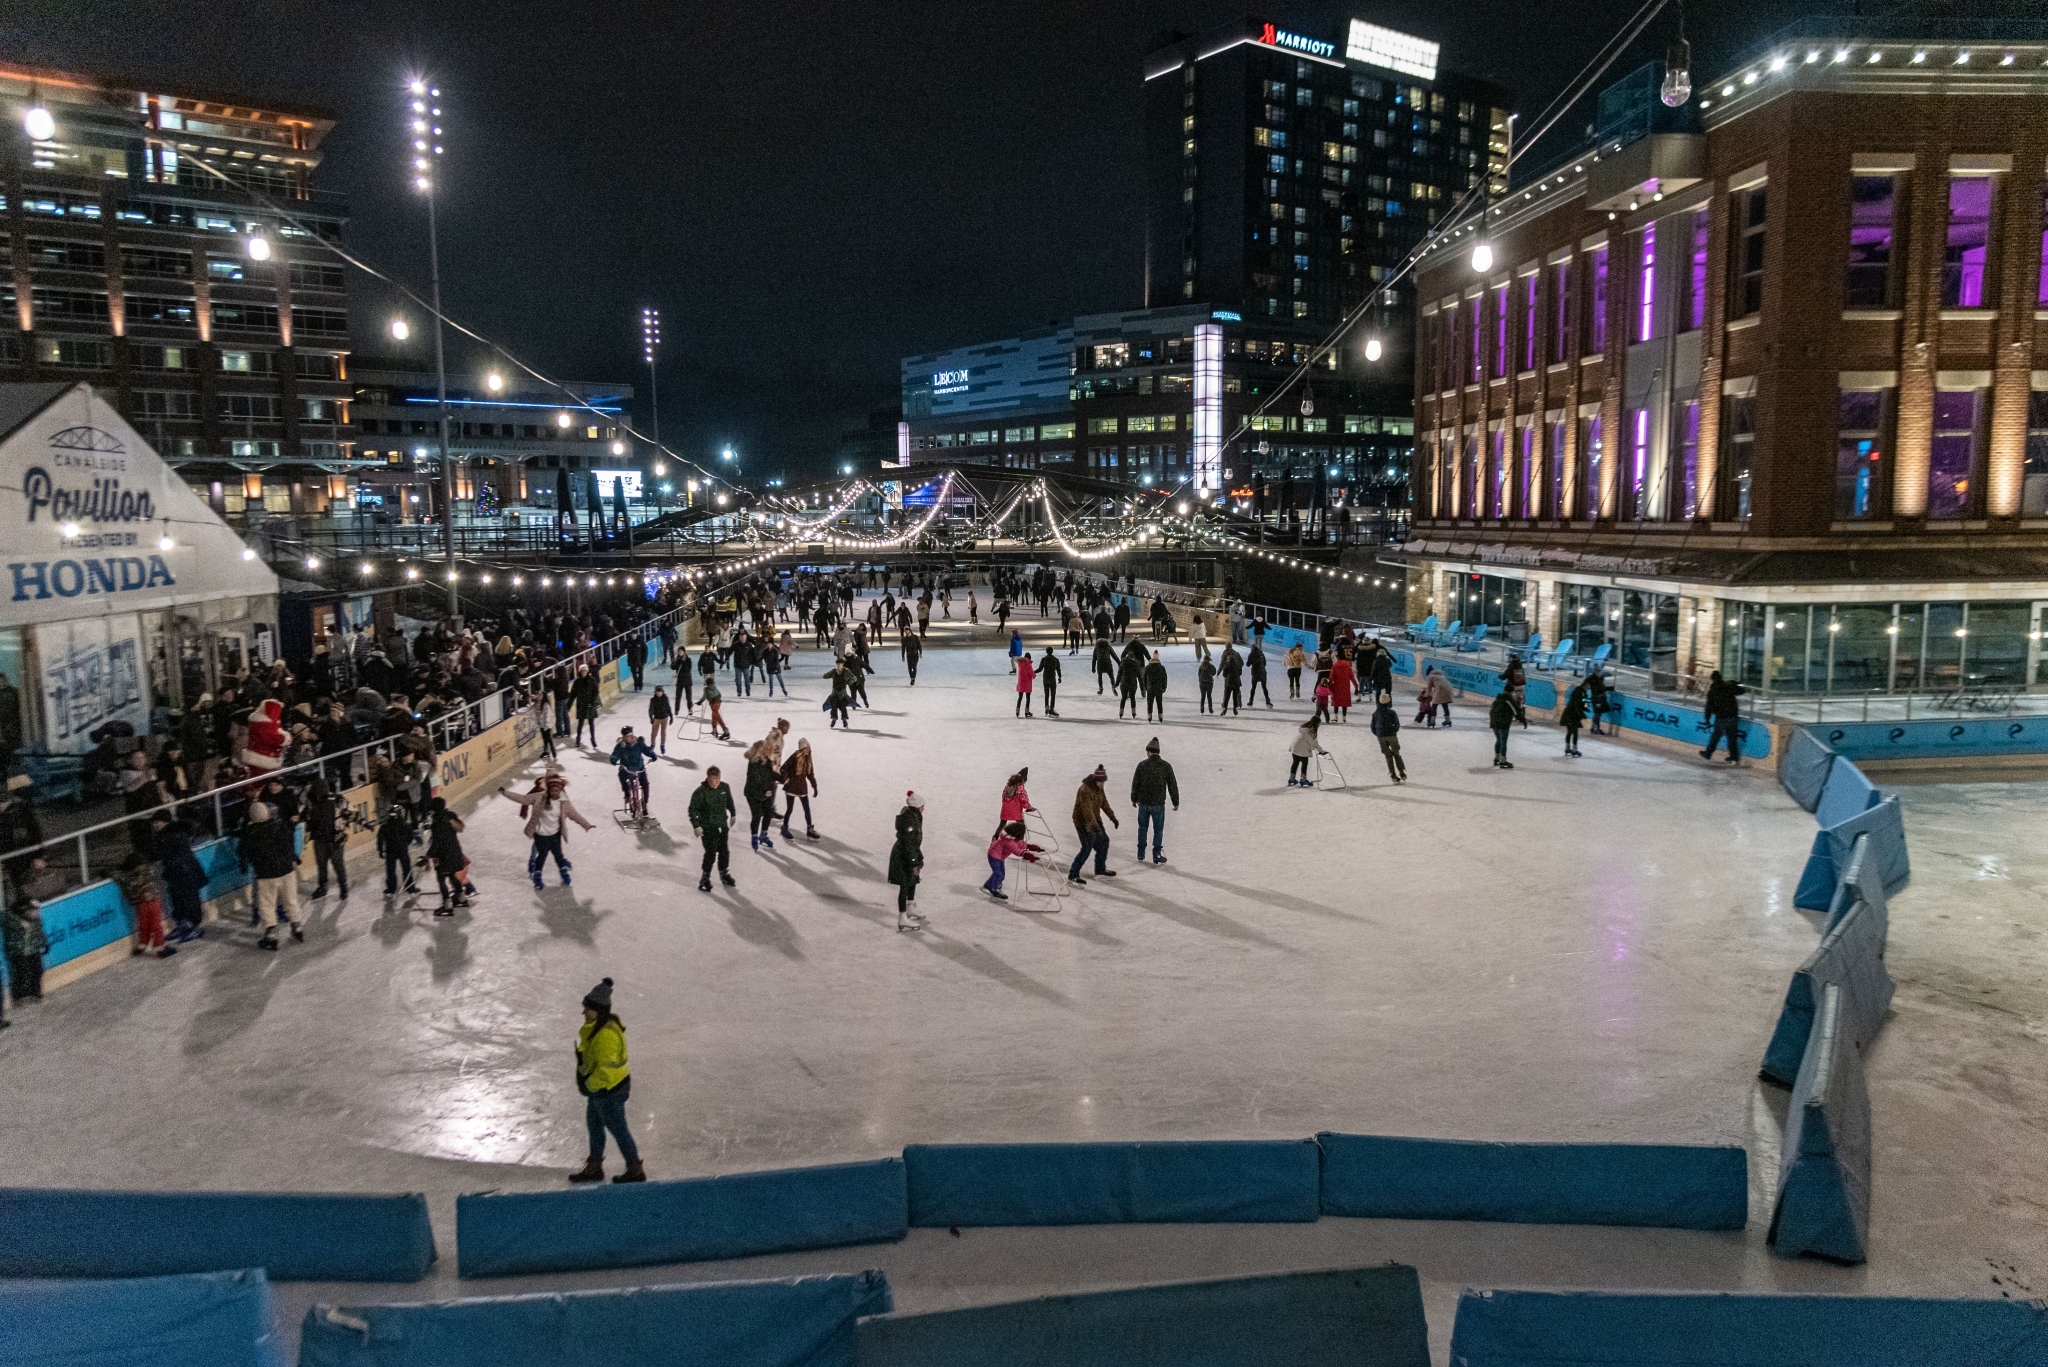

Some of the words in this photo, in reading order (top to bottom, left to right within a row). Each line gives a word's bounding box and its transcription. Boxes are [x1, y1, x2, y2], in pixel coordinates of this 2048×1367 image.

[1275, 30, 1335, 58] MARRIOTT
[933, 369, 969, 386] LECOM
[933, 385, 969, 395] HARBORCENTER
[54, 454, 126, 472] CANALSIDE
[23, 466, 156, 522] Pavilion
[8, 554, 176, 602] HONDA
[1634, 707, 1679, 728] ROAR
[442, 751, 469, 787] ONLY
